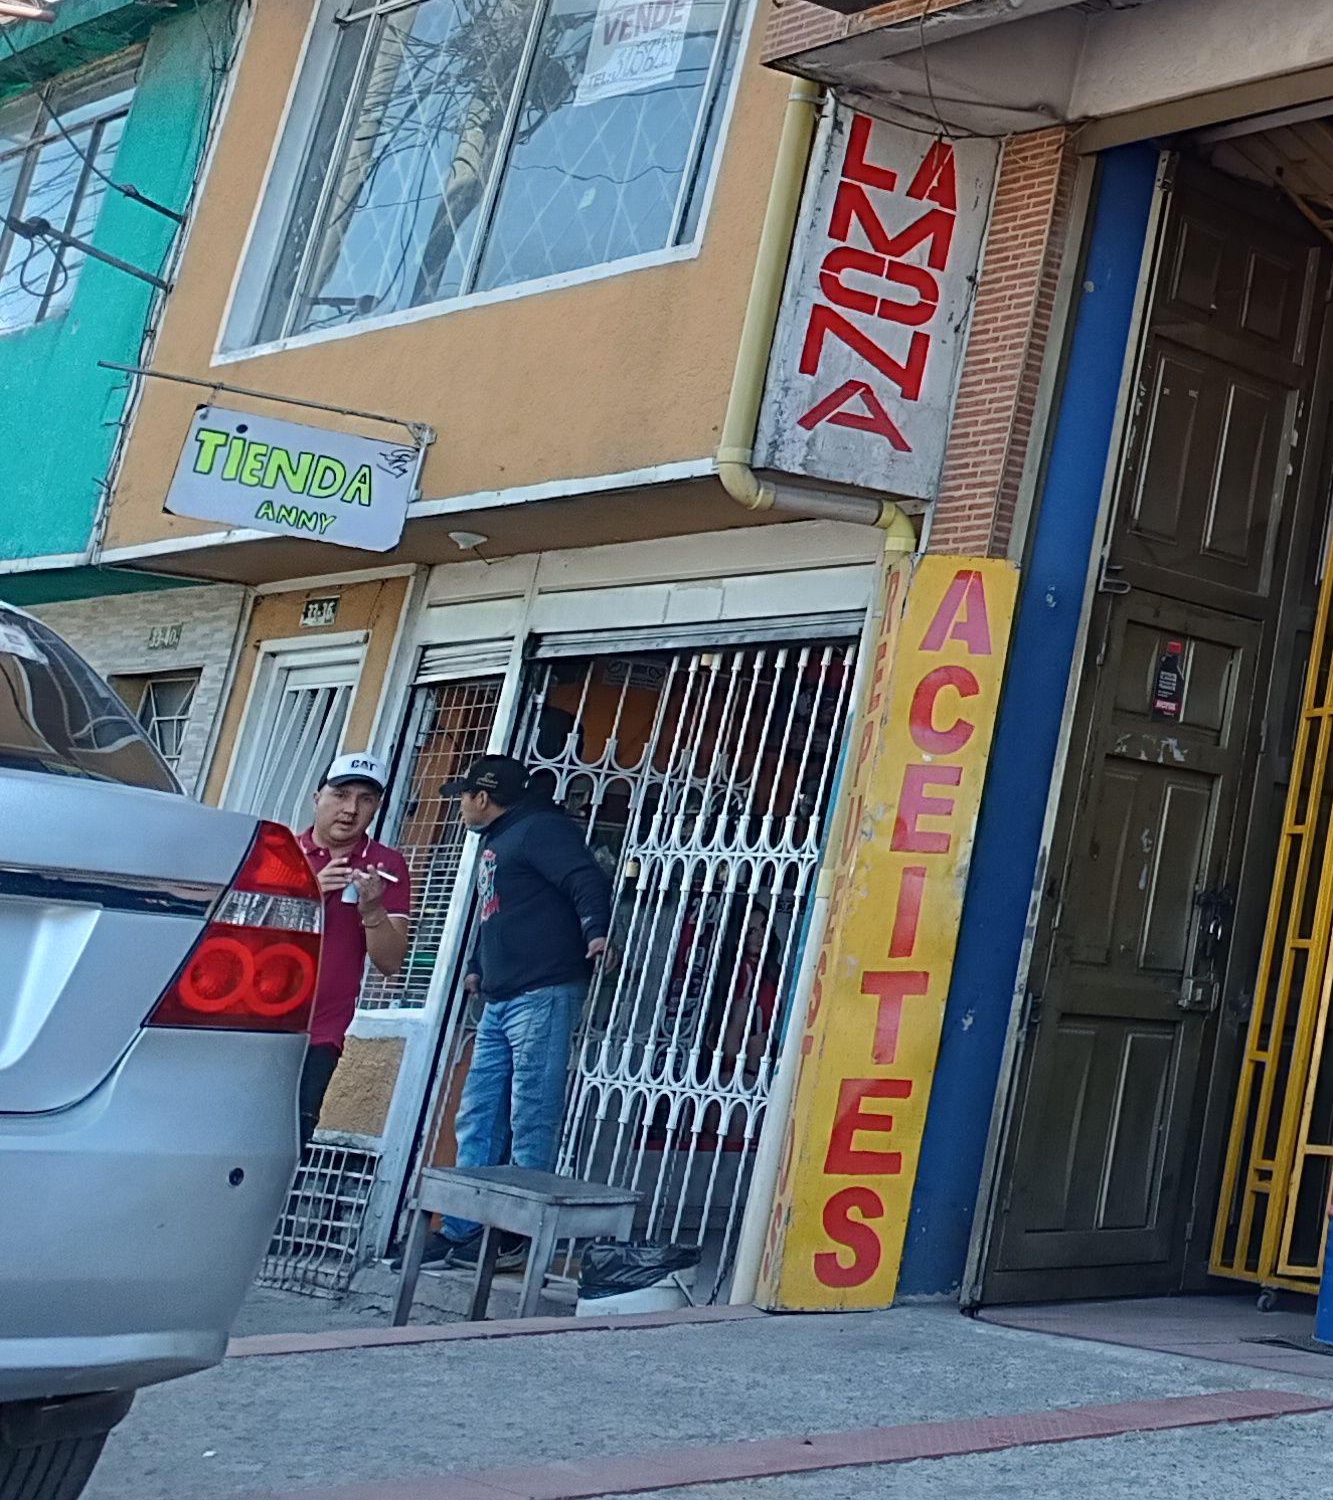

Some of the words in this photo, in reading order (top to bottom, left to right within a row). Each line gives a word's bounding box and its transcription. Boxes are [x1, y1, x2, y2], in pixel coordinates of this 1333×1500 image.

[842, 114, 957, 211] LA
[797, 178, 957, 452] MONA
[255, 501, 337, 534] ANNY
[350, 759, 378, 771] CAT
[813, 569, 993, 1289] ACEITES
